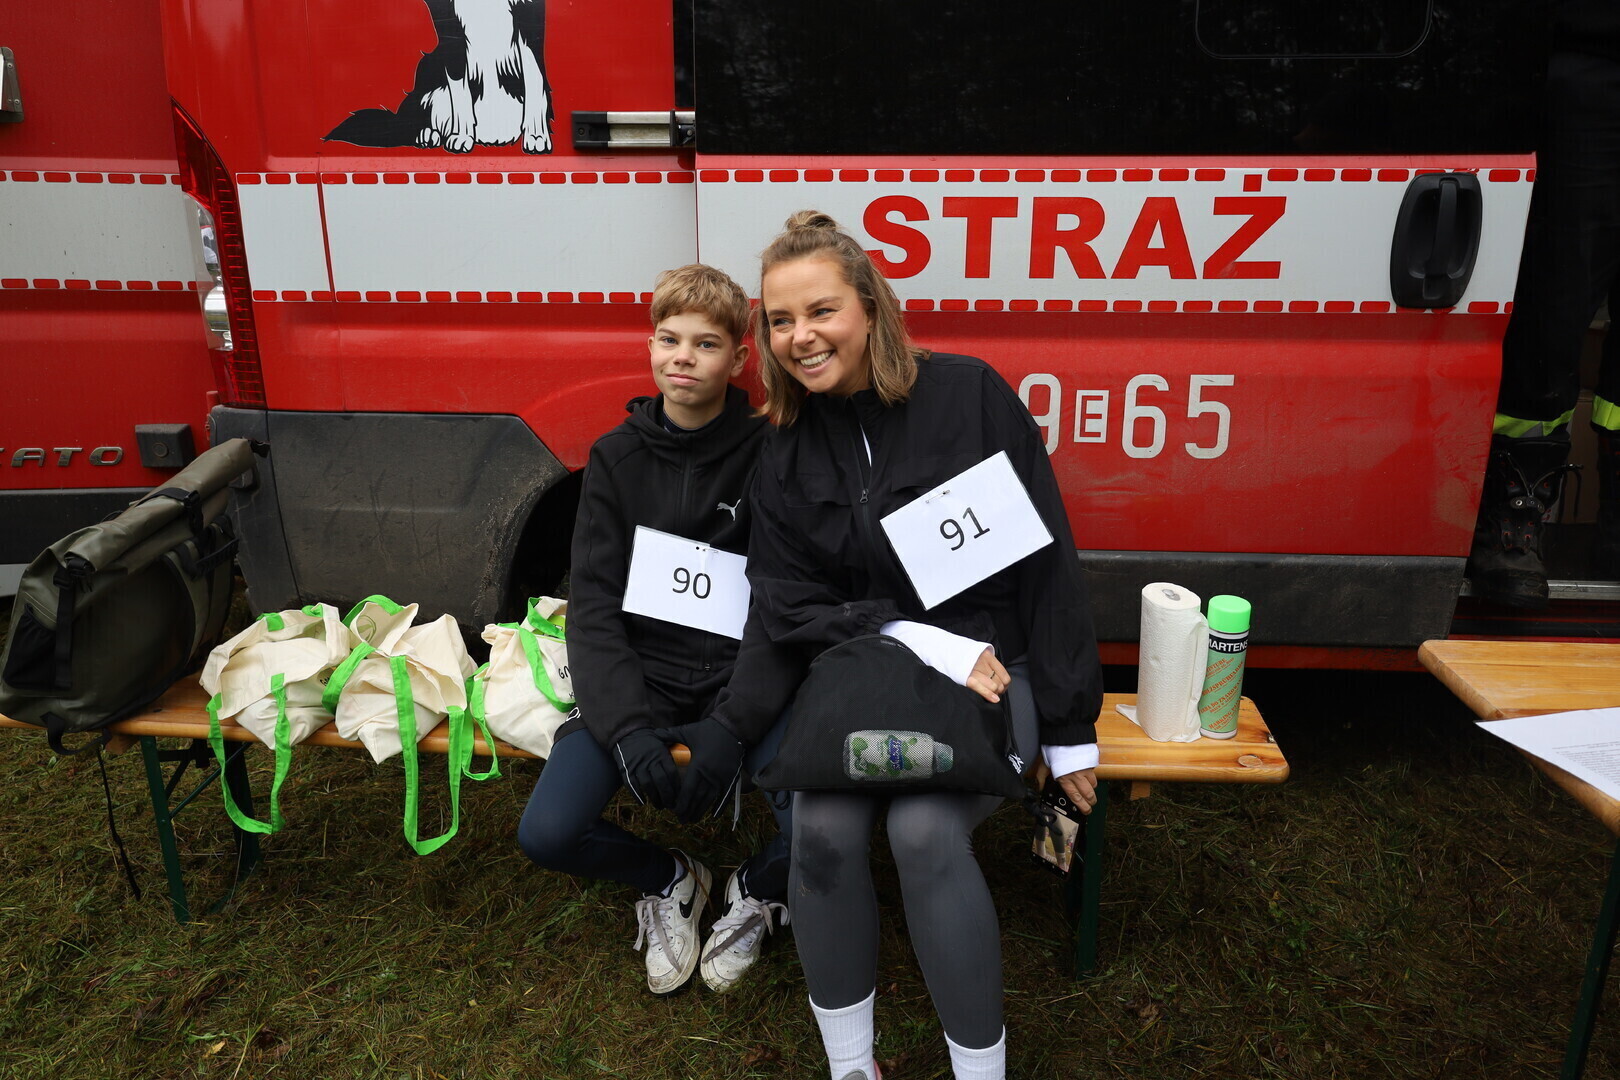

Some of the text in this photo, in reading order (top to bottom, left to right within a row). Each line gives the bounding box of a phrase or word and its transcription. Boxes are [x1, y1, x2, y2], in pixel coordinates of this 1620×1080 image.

[862, 174, 1287, 280] STRAŻ
[0, 446, 124, 467] ATO
[939, 506, 991, 551] 91
[672, 567, 712, 600] 90
